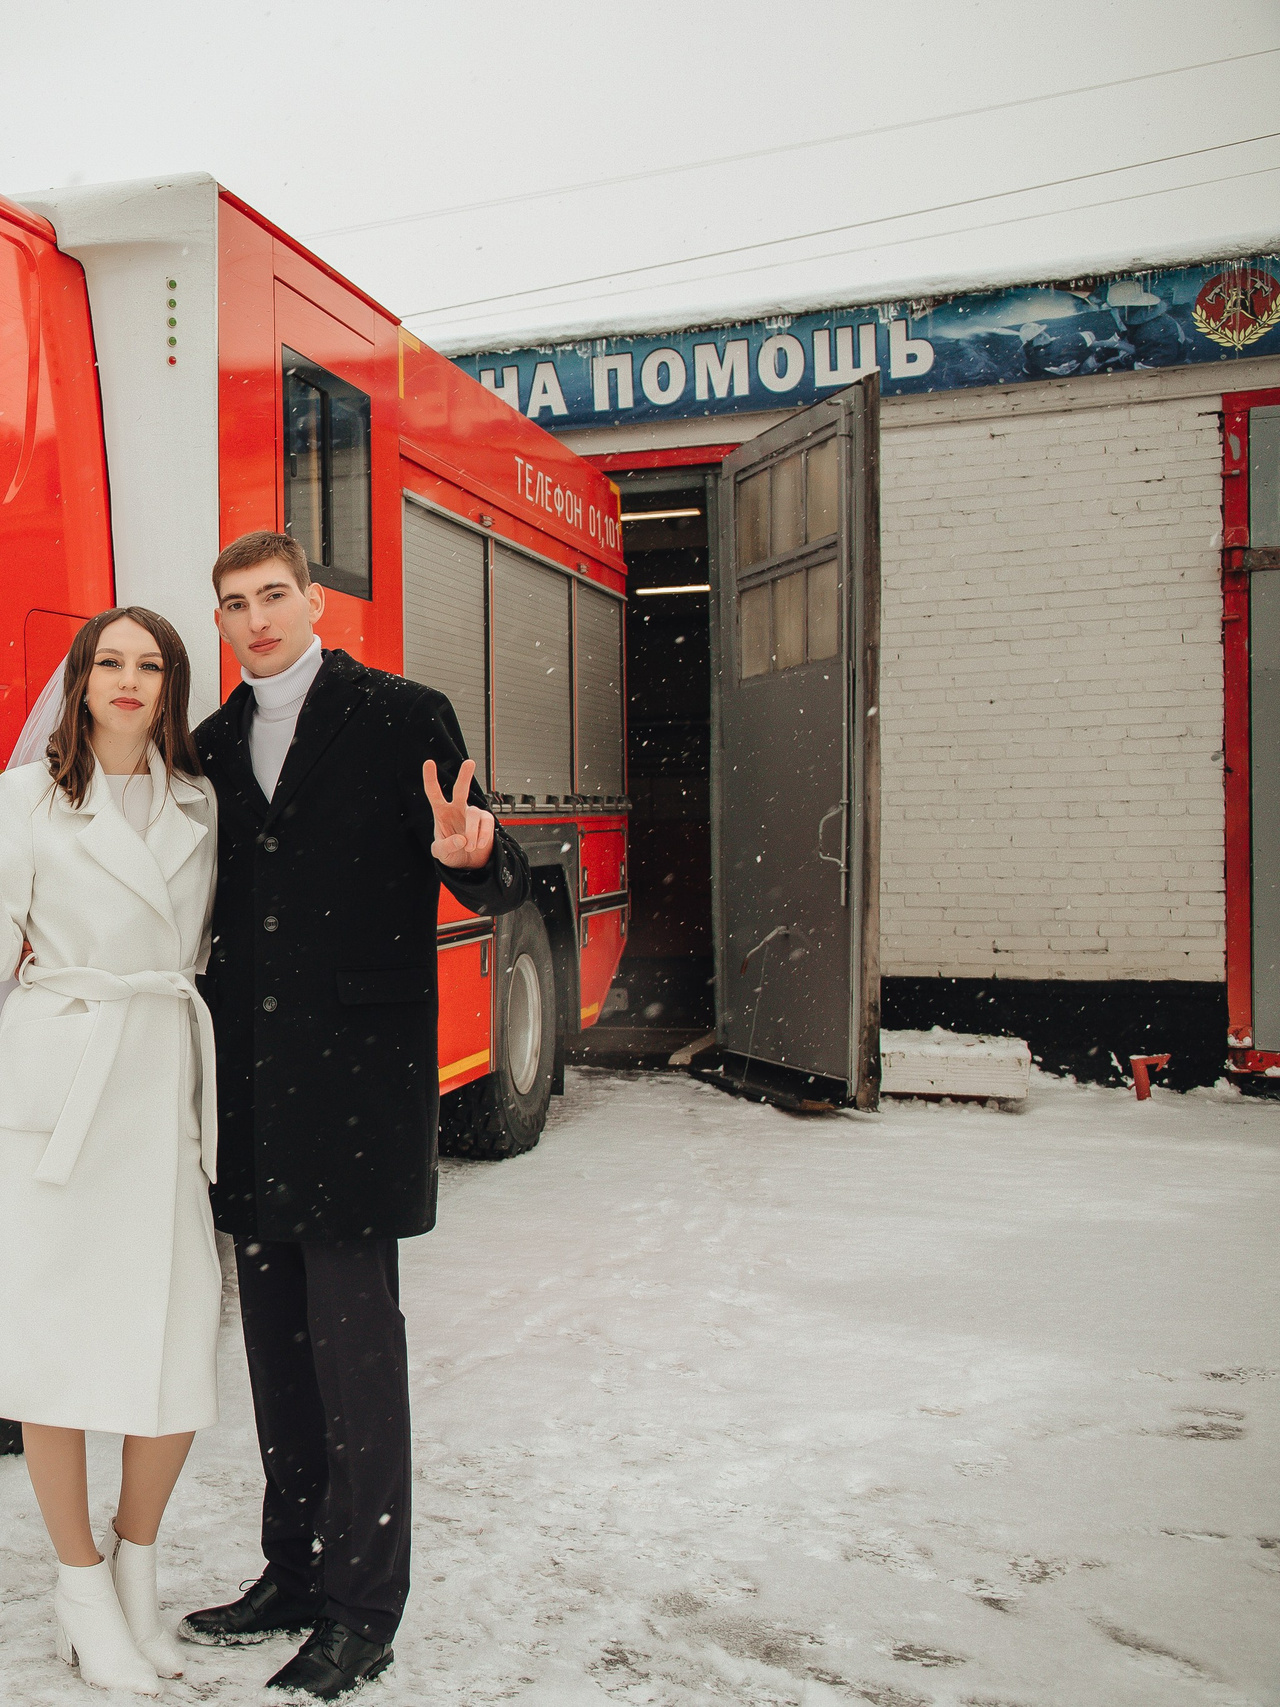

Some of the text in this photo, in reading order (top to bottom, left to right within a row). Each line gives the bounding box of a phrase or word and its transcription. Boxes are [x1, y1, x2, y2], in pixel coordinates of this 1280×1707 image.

[479, 318, 936, 419] НА ПОМОЩЬ
[514, 455, 583, 531] ТЕЛЕФОН
